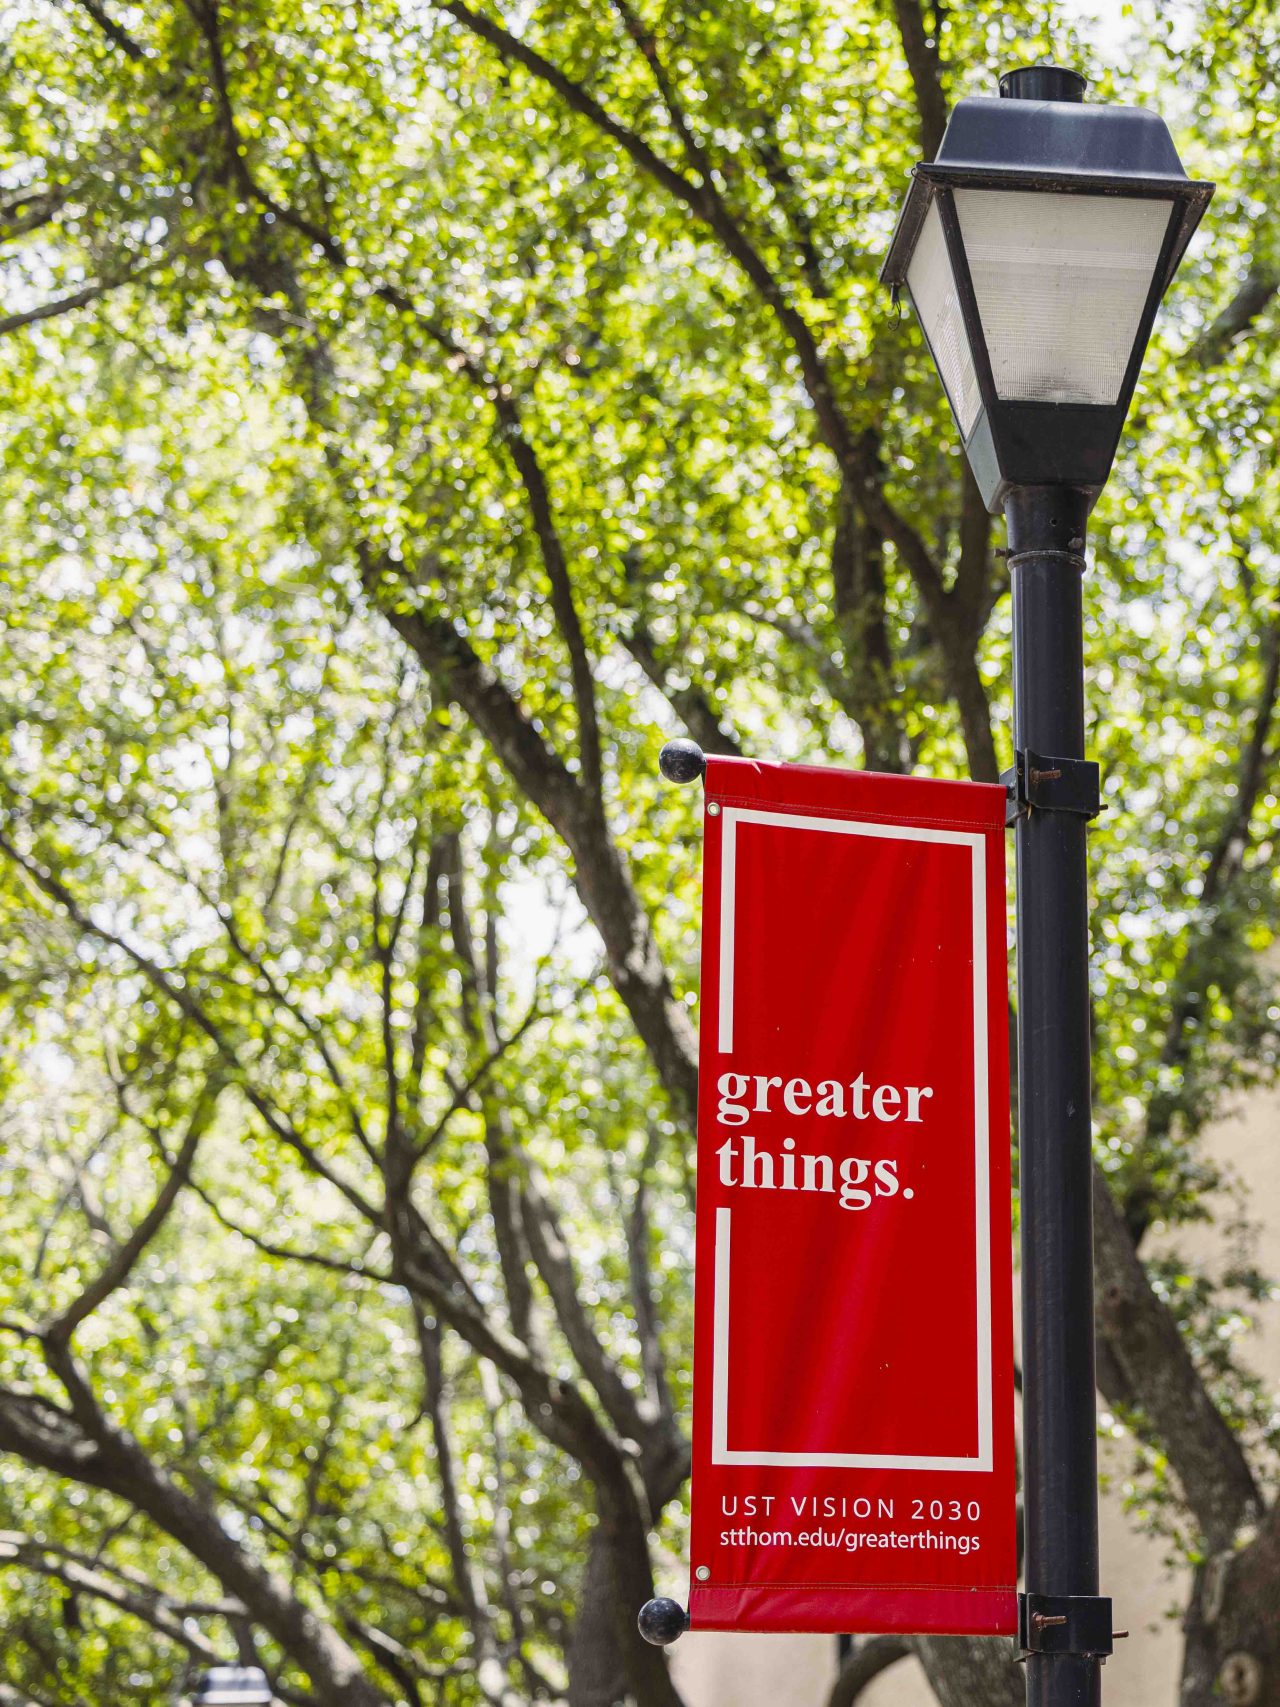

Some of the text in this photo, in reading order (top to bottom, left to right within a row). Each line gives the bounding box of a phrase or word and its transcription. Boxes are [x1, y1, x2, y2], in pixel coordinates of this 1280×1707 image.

[716, 1070, 934, 1126] greater
[715, 1135, 914, 1212] things.
[721, 1495, 981, 1521] UST VISION 2030
[719, 1525, 981, 1555] stthom.edu/greaterthings
